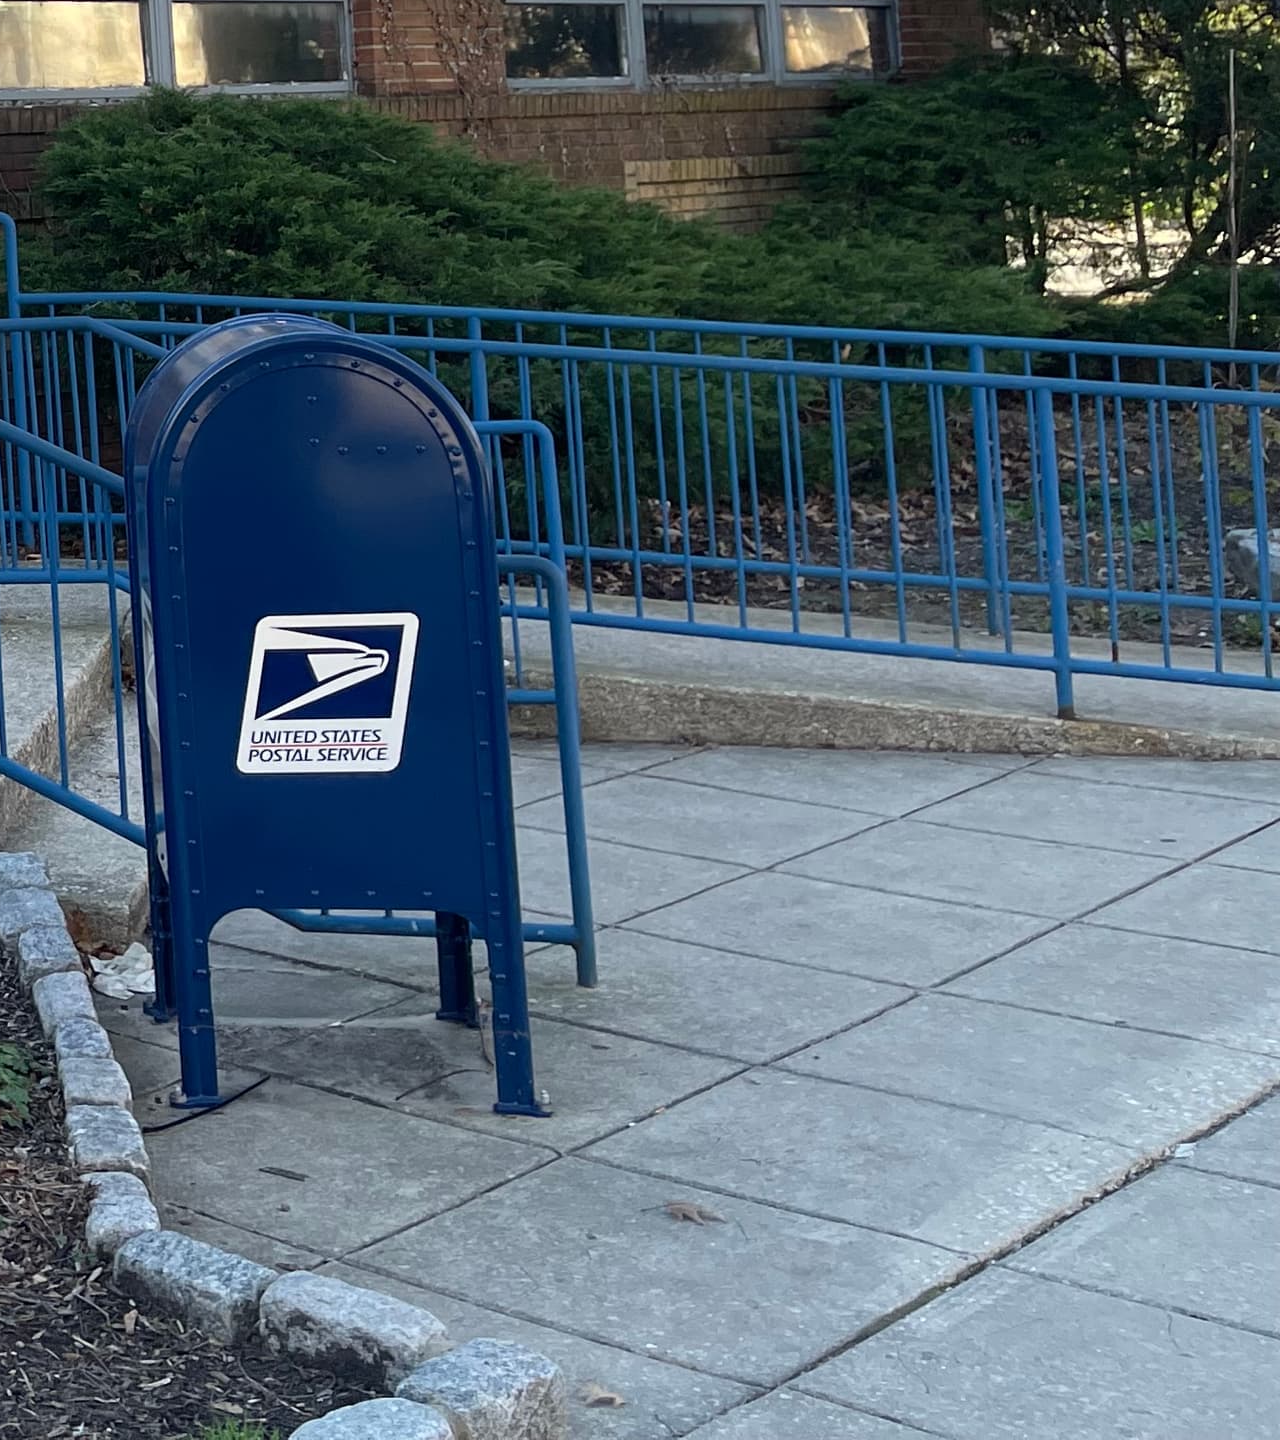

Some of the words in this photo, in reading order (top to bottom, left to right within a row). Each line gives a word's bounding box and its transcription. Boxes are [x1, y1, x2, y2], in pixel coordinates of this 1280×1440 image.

[251, 730, 317, 744] UNITED
[320, 729, 382, 743] STATES
[248, 748, 313, 762] POSTAL
[317, 747, 388, 761] SERVICE
